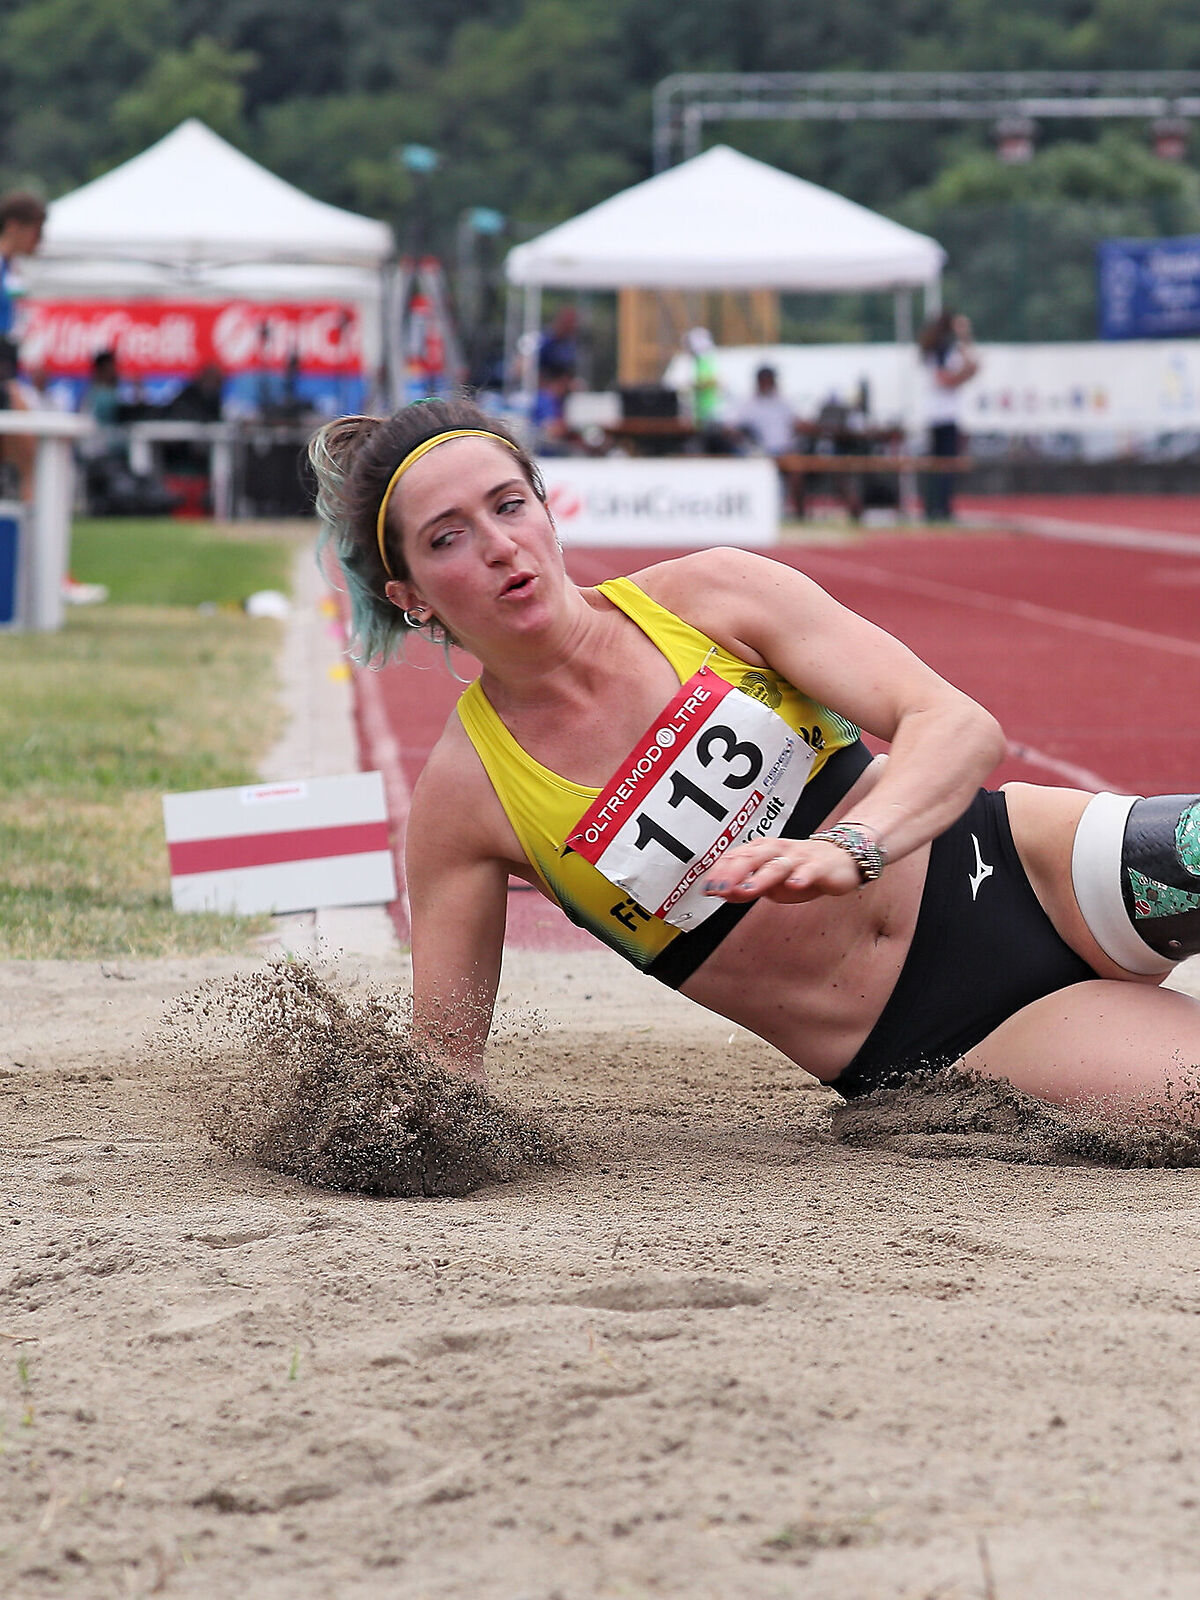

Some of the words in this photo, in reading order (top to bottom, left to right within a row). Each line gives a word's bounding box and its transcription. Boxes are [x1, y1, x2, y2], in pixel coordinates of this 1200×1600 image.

[633, 724, 763, 865] 113
[663, 836, 730, 912] CONCESIO
[728, 793, 761, 838] 2021
